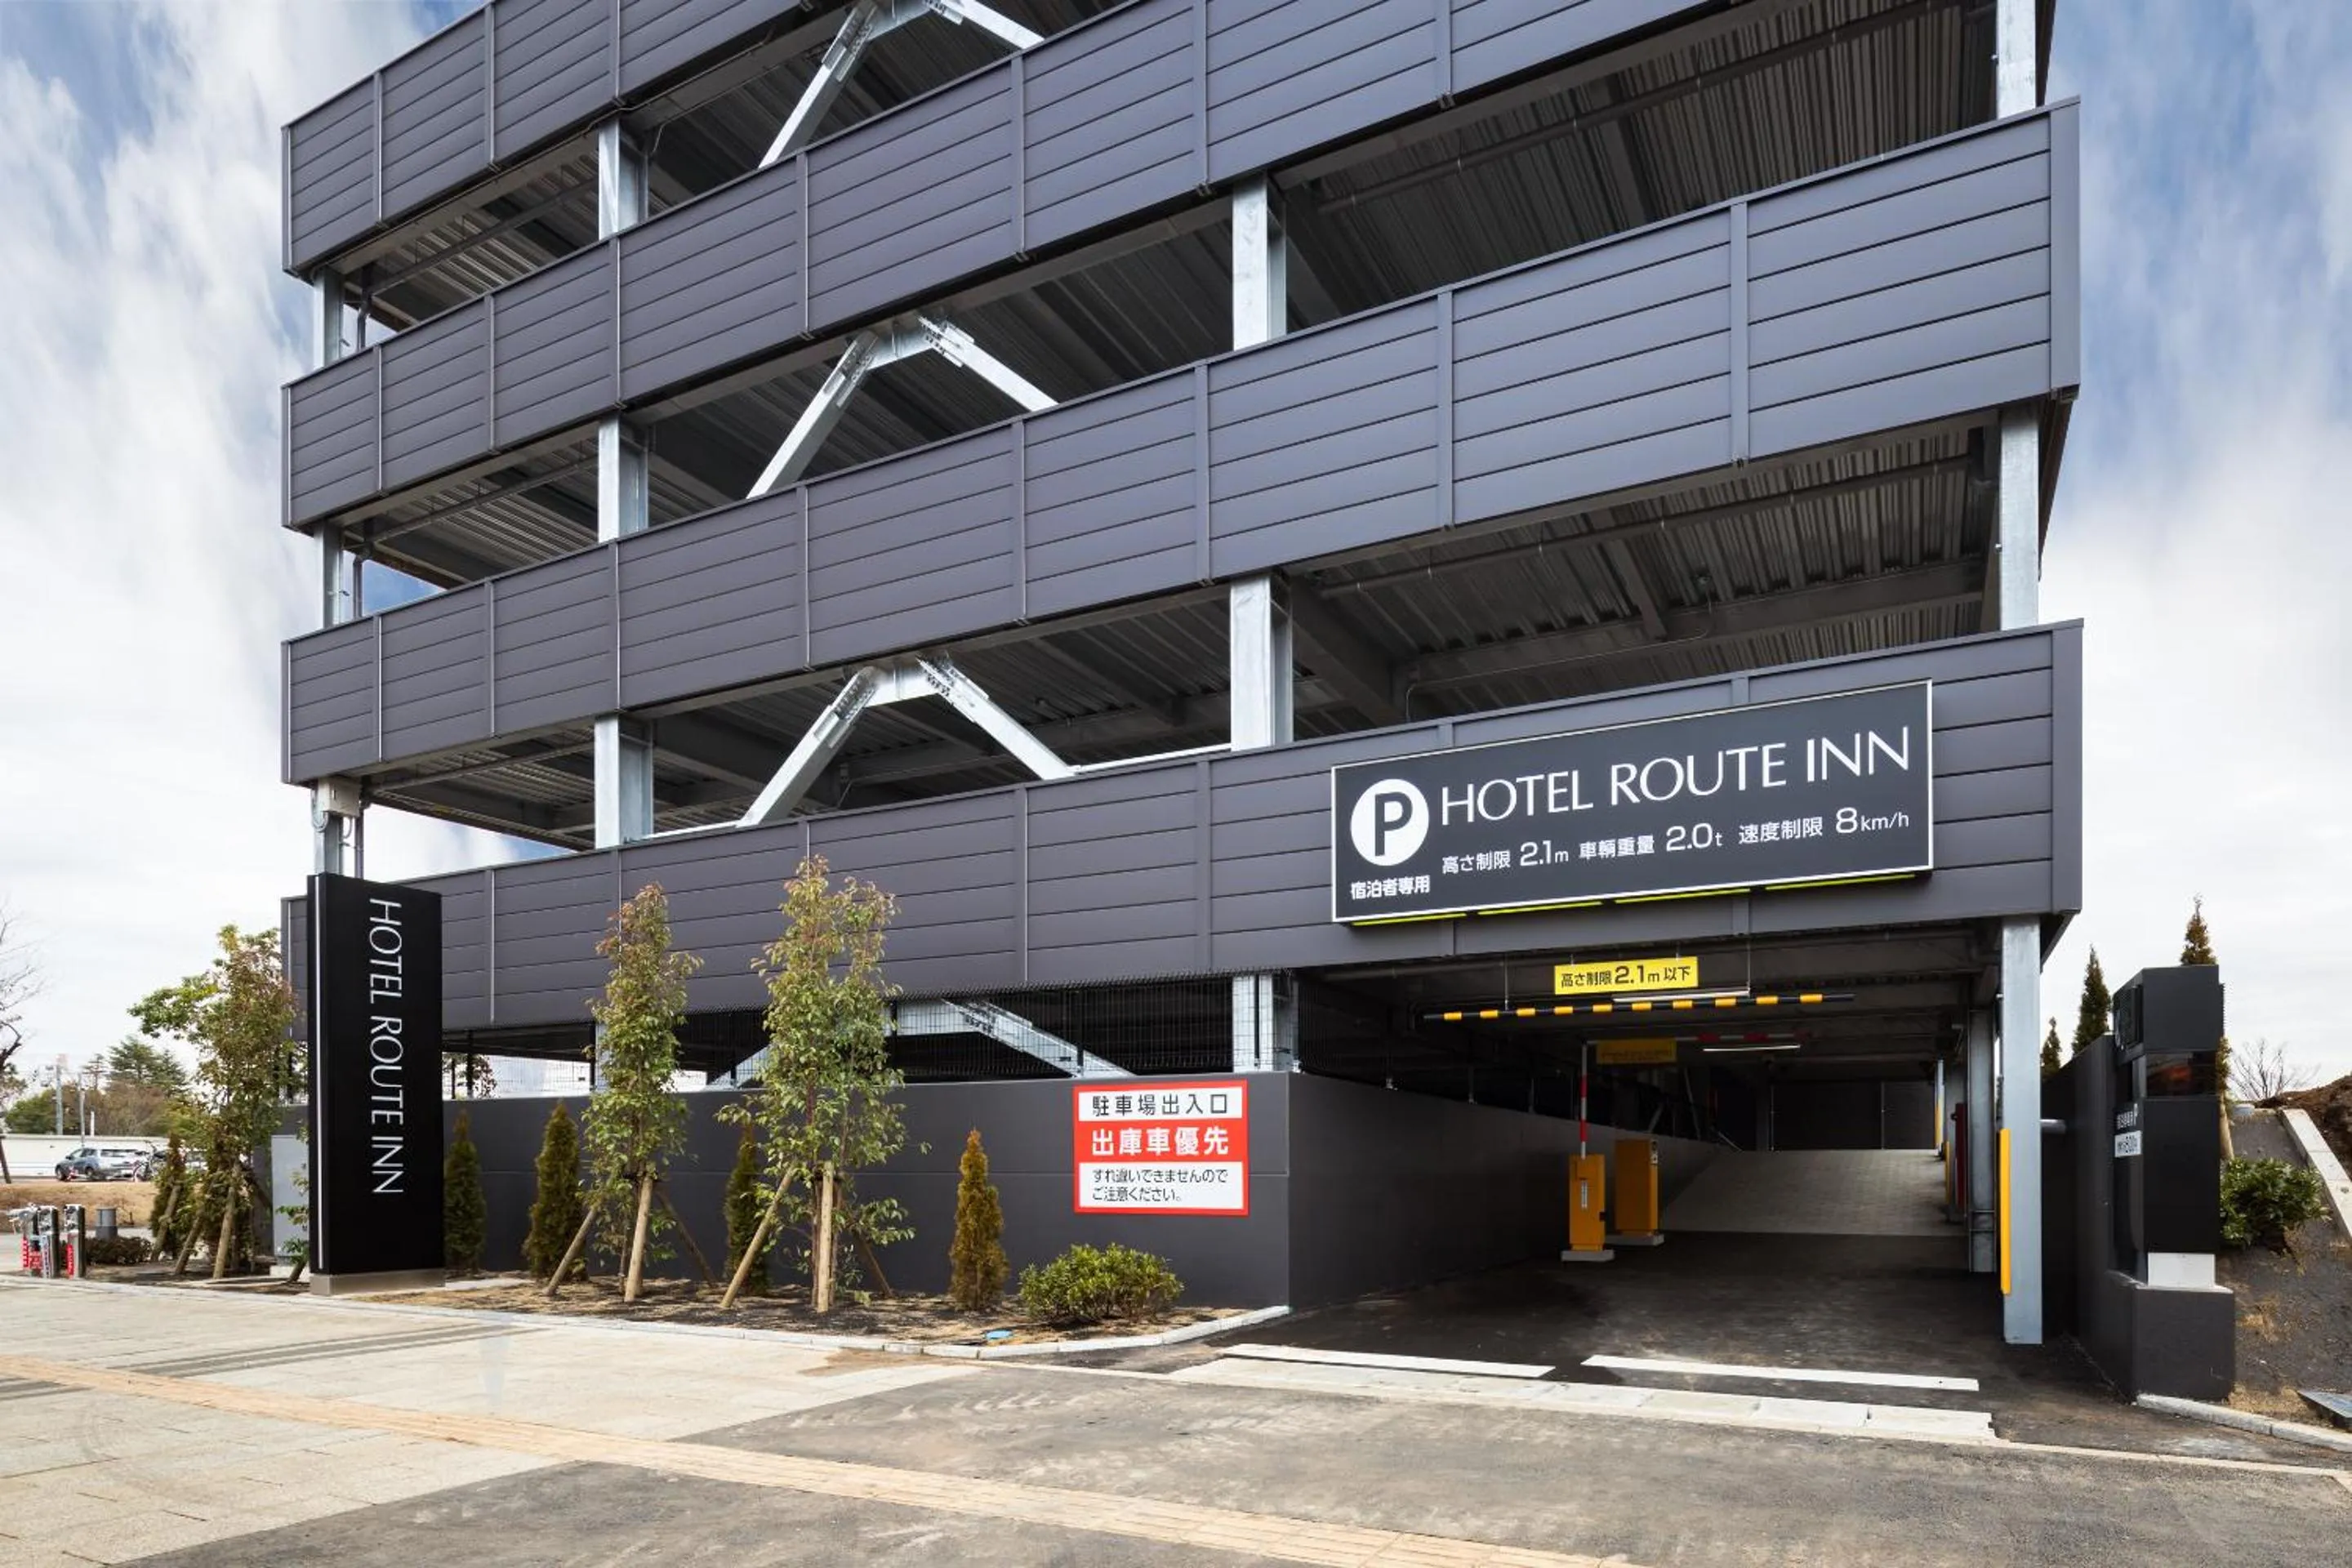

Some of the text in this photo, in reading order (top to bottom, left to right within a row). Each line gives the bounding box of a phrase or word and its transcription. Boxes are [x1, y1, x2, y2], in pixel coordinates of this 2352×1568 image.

[1441, 726, 1909, 825] HOTEL ROUTE INN
[1441, 850, 1511, 875] 高さ制限
[1520, 840, 1569, 866] 2.1m
[1666, 822, 1722, 851] 2.0t
[1739, 817, 1823, 844] 速度制限
[1835, 807, 1909, 834] 8km/h
[369, 898, 403, 1193] HOTEL ROUTE INN
[1092, 1094, 1227, 1116] 駐車場出入口
[1091, 1126, 1229, 1156] 出庫車優先
[1093, 1169, 1228, 1183] すれ違いできませんので
[1093, 1187, 1182, 1202] ご注意ください。
